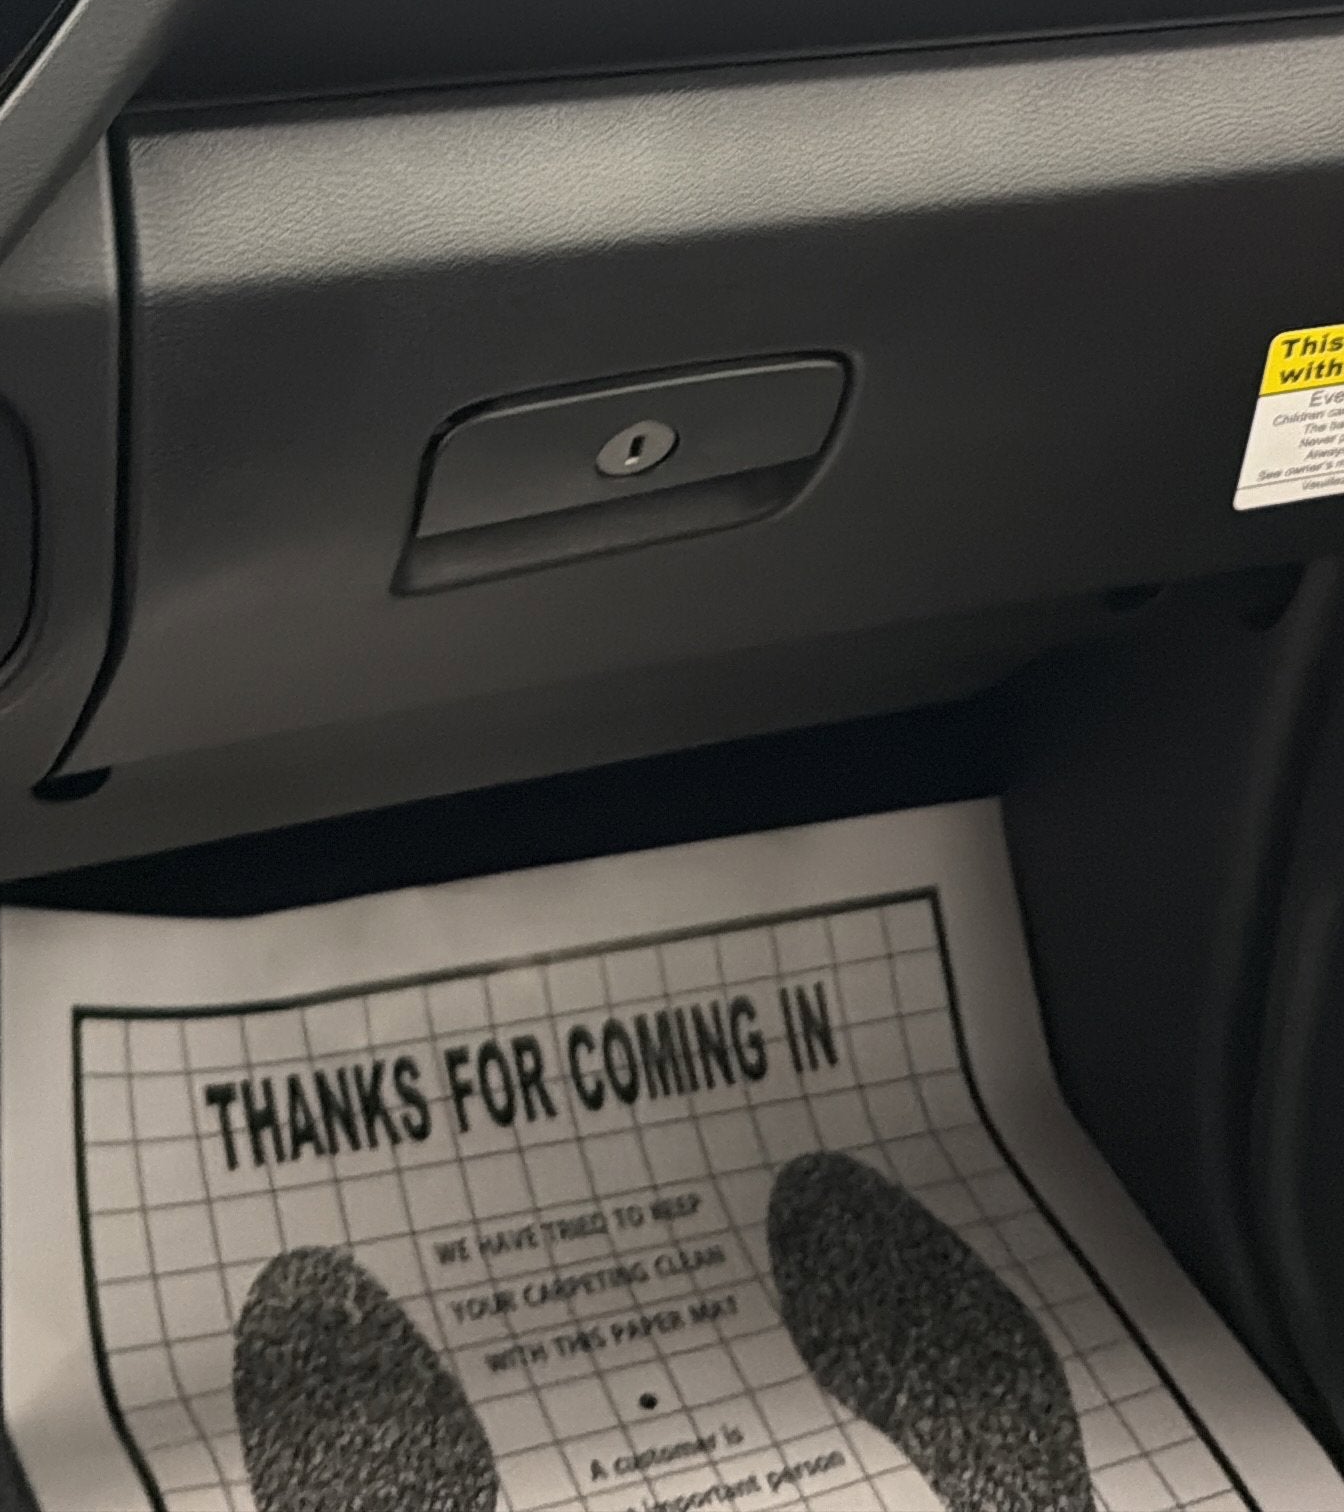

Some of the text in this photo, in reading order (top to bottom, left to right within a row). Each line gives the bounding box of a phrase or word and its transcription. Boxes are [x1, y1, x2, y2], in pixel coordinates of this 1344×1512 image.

[1280, 358, 1344, 385] with
[1281, 335, 1344, 359] This
[205, 981, 839, 1172] THANKS FOR COMING IN
[433, 1192, 702, 1266] WE HAVE TRIED TO KEEP
[450, 1244, 727, 1324] YOUR CARPETING CLEAN
[484, 1294, 739, 1373] WITH THIS PAPER MAT
[590, 1422, 744, 1482] A customer is
[766, 1450, 846, 1493] person
